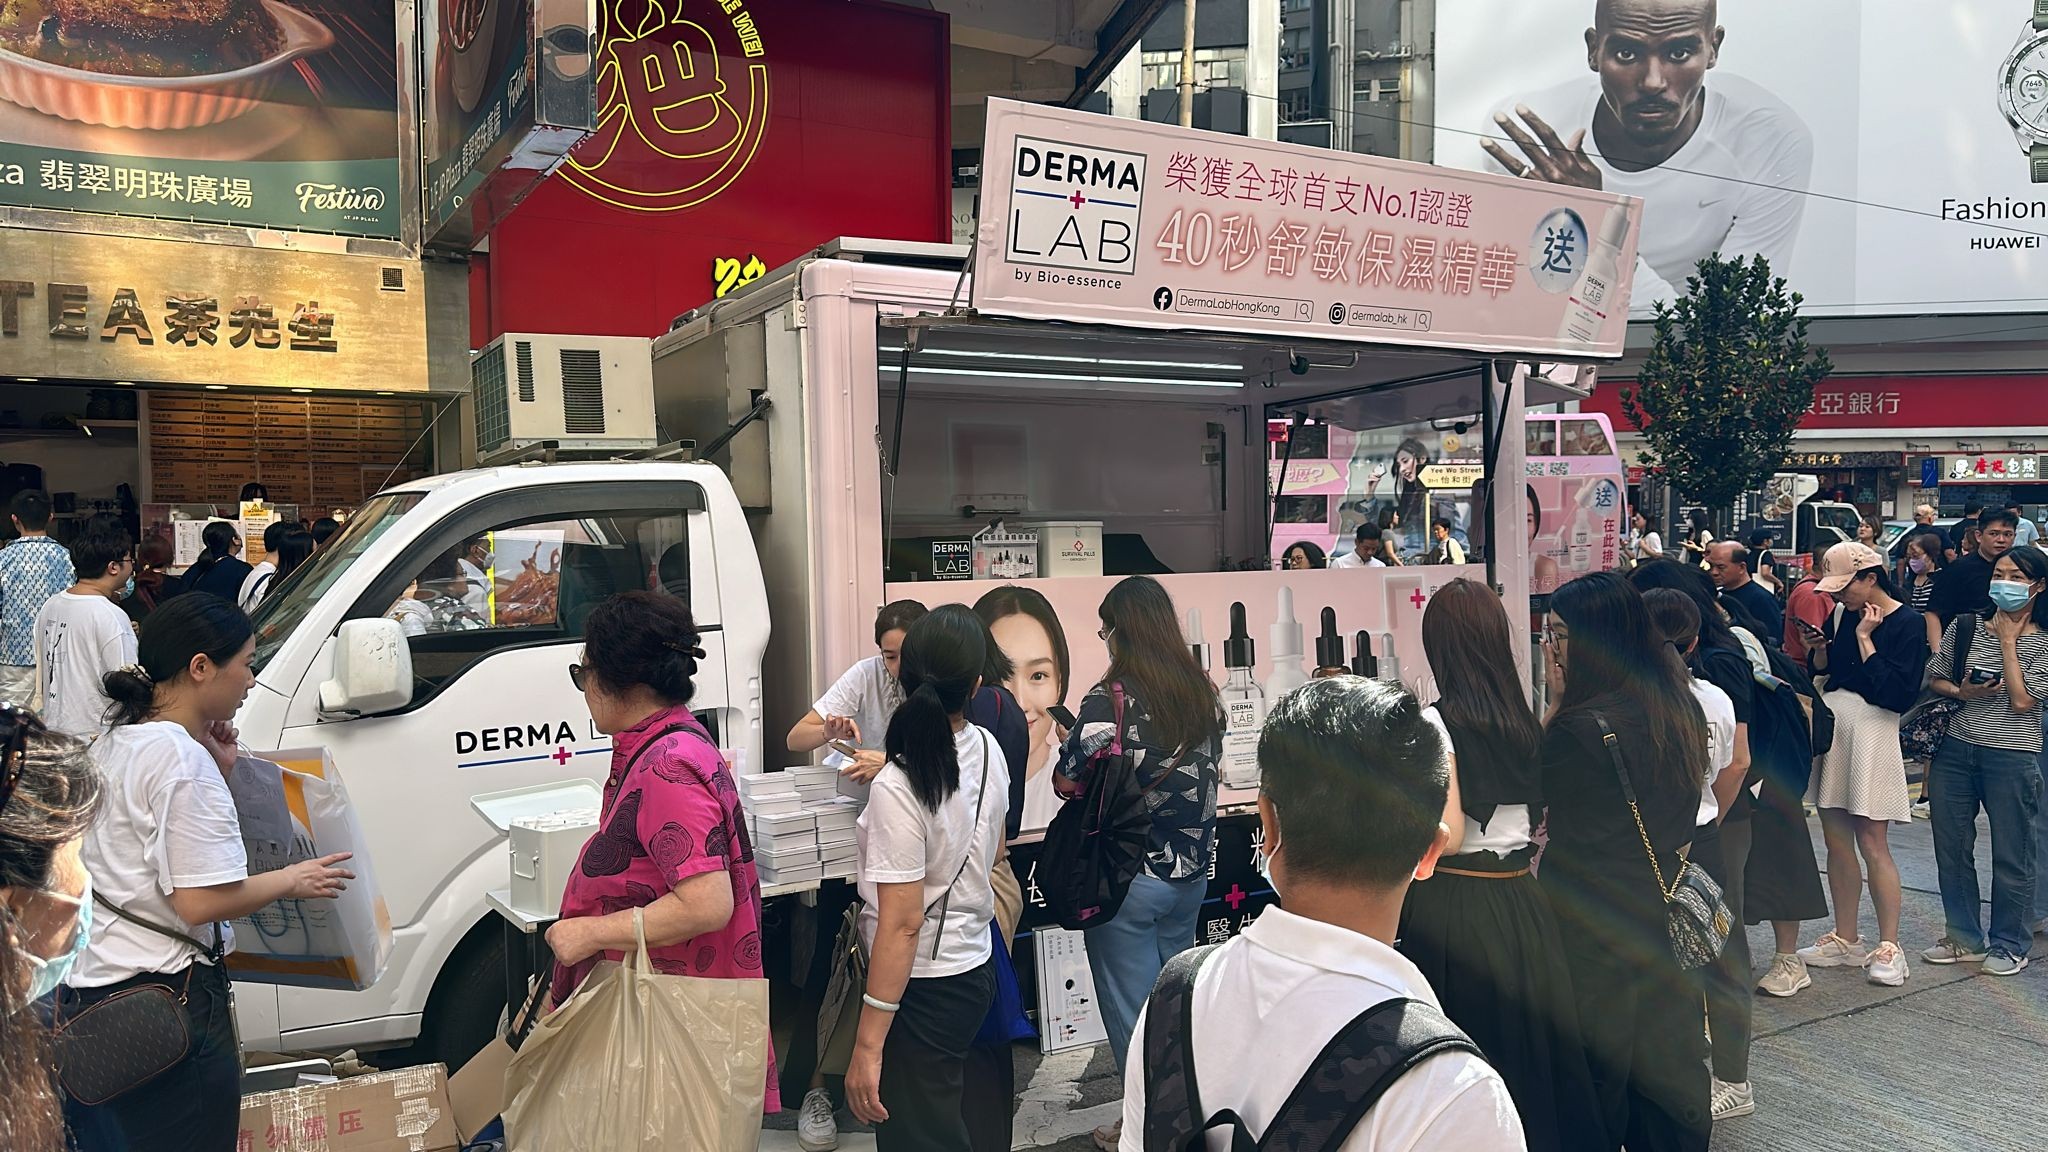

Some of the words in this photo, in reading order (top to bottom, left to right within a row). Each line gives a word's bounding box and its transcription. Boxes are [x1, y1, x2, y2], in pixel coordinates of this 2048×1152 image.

[732, 11, 765, 57] WEI
[1018, 147, 1139, 192] DERMA
[40, 159, 253, 209] 翡翠明珠廣場
[1164, 151, 1473, 229] 榮獲全球首支No.1認證
[295, 182, 385, 213] Festiva
[1942, 197, 2046, 220] Fashion
[1013, 209, 1131, 264] LAB
[1970, 236, 2040, 250] HUAWEI
[1156, 209, 1517, 297] 40秒舒敏保濕精華
[1541, 226, 1575, 274] 送
[1015, 268, 1031, 283] by
[1038, 271, 1122, 289] Bio-essence
[1587, 276, 1605, 290] DERMA
[0, 280, 154, 346] TEA
[164, 291, 338, 353] 茶先生
[1180, 295, 1280, 316] DermaLabHongKong
[1352, 311, 1408, 326] dermalab_hk
[1441, 476, 1471, 484] 怡和街
[1460, 466, 1482, 474] Street
[1596, 487, 1612, 507] 送
[934, 544, 969, 553] DERMA
[934, 559, 970, 573] LAB
[1232, 714, 1254, 723] LAB
[456, 721, 576, 754] DERMA
